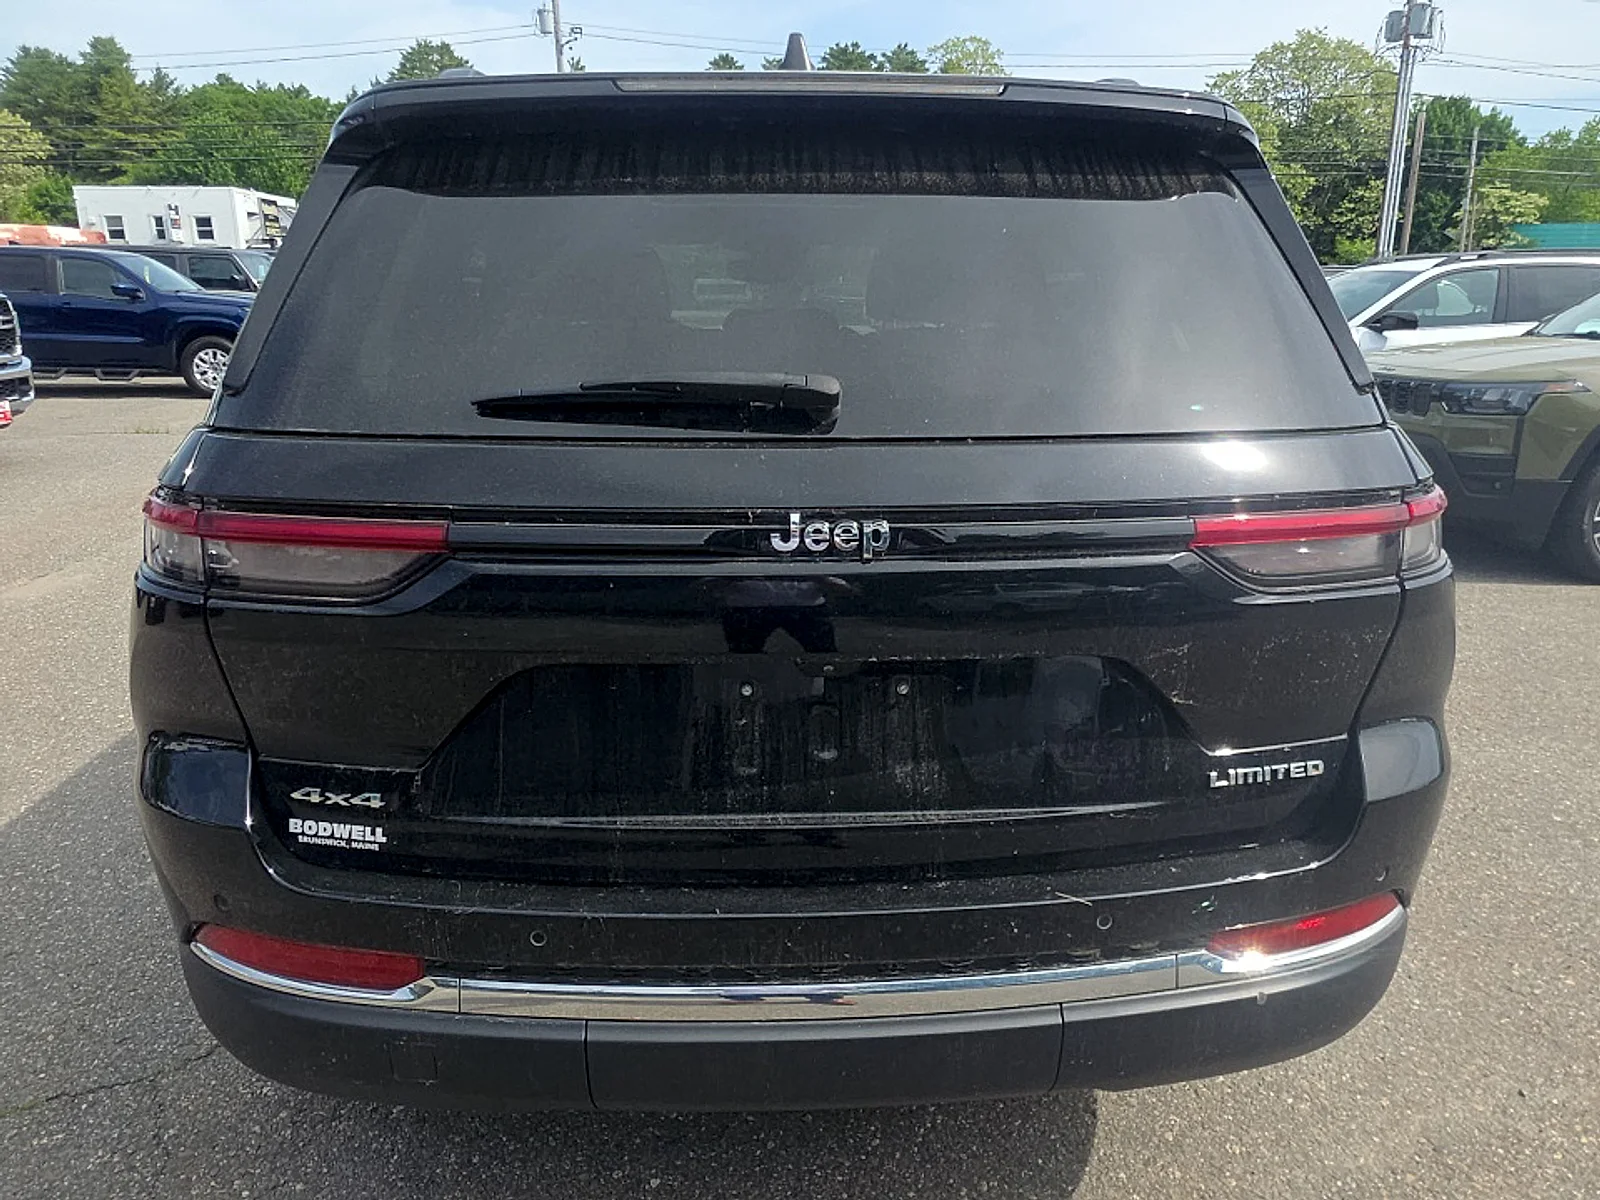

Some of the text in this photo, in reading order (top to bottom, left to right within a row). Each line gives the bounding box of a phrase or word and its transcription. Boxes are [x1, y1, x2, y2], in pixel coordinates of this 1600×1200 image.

[770, 513, 890, 559] Jeep
[1209, 760, 1325, 788] LIMITED
[290, 787, 386, 808] 4x4
[288, 818, 387, 843] BODWELL
